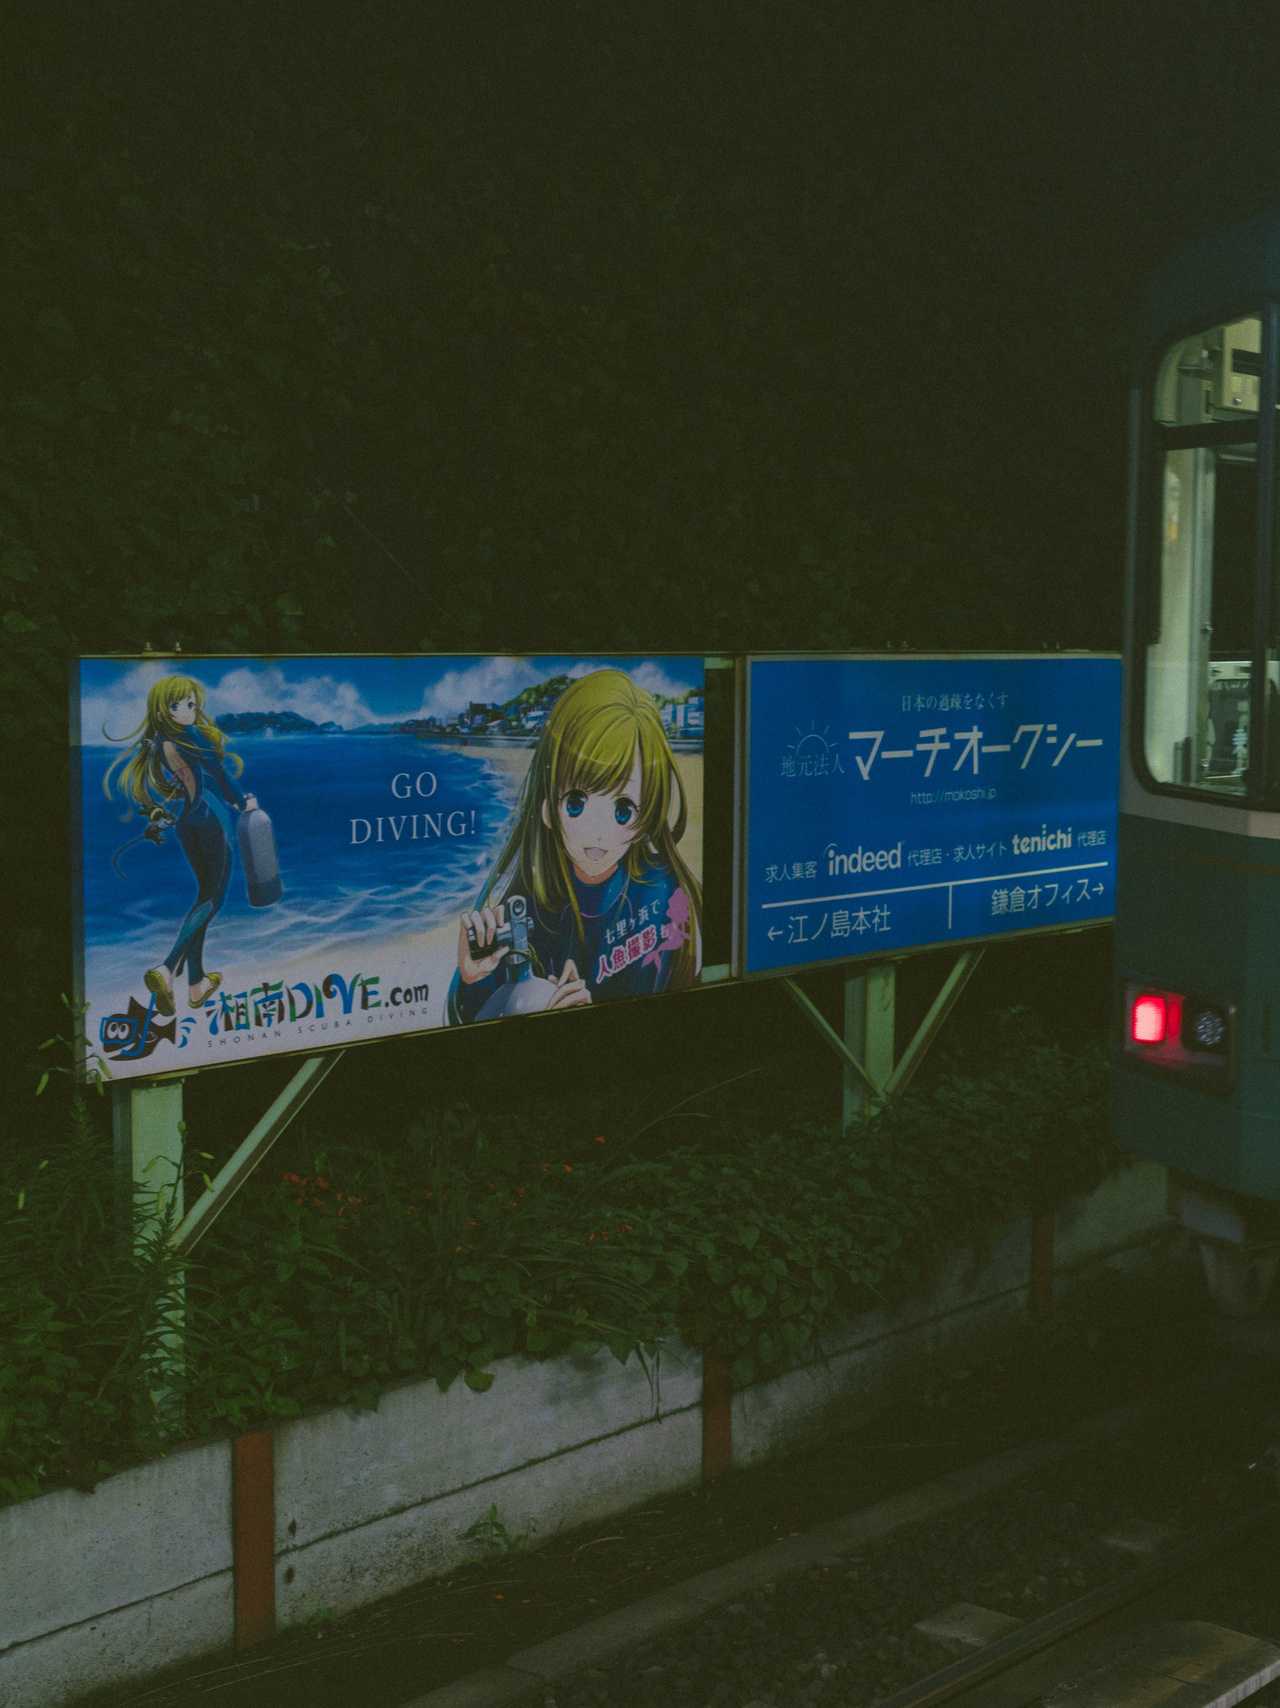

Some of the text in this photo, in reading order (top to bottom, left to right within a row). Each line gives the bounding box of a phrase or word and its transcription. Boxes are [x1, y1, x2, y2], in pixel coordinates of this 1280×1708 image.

[902, 692, 1008, 713] 日本の過疎をなくす
[780, 724, 1103, 781] 地元法人 マーチオークシー
[391, 771, 437, 798] GO
[349, 810, 475, 845] DIVING!
[765, 860, 818, 883] 求人集客
[823, 842, 902, 877] indeed
[1012, 824, 1072, 855] tenichi
[1077, 829, 1107, 848] 代理店
[990, 878, 1092, 917] 鎌倉オフィス
[787, 903, 892, 945] 江ノ島本社
[205, 972, 430, 1037] 湘南DIVE.com
[207, 1006, 429, 1049] SHONAN SCUBA DIVING
